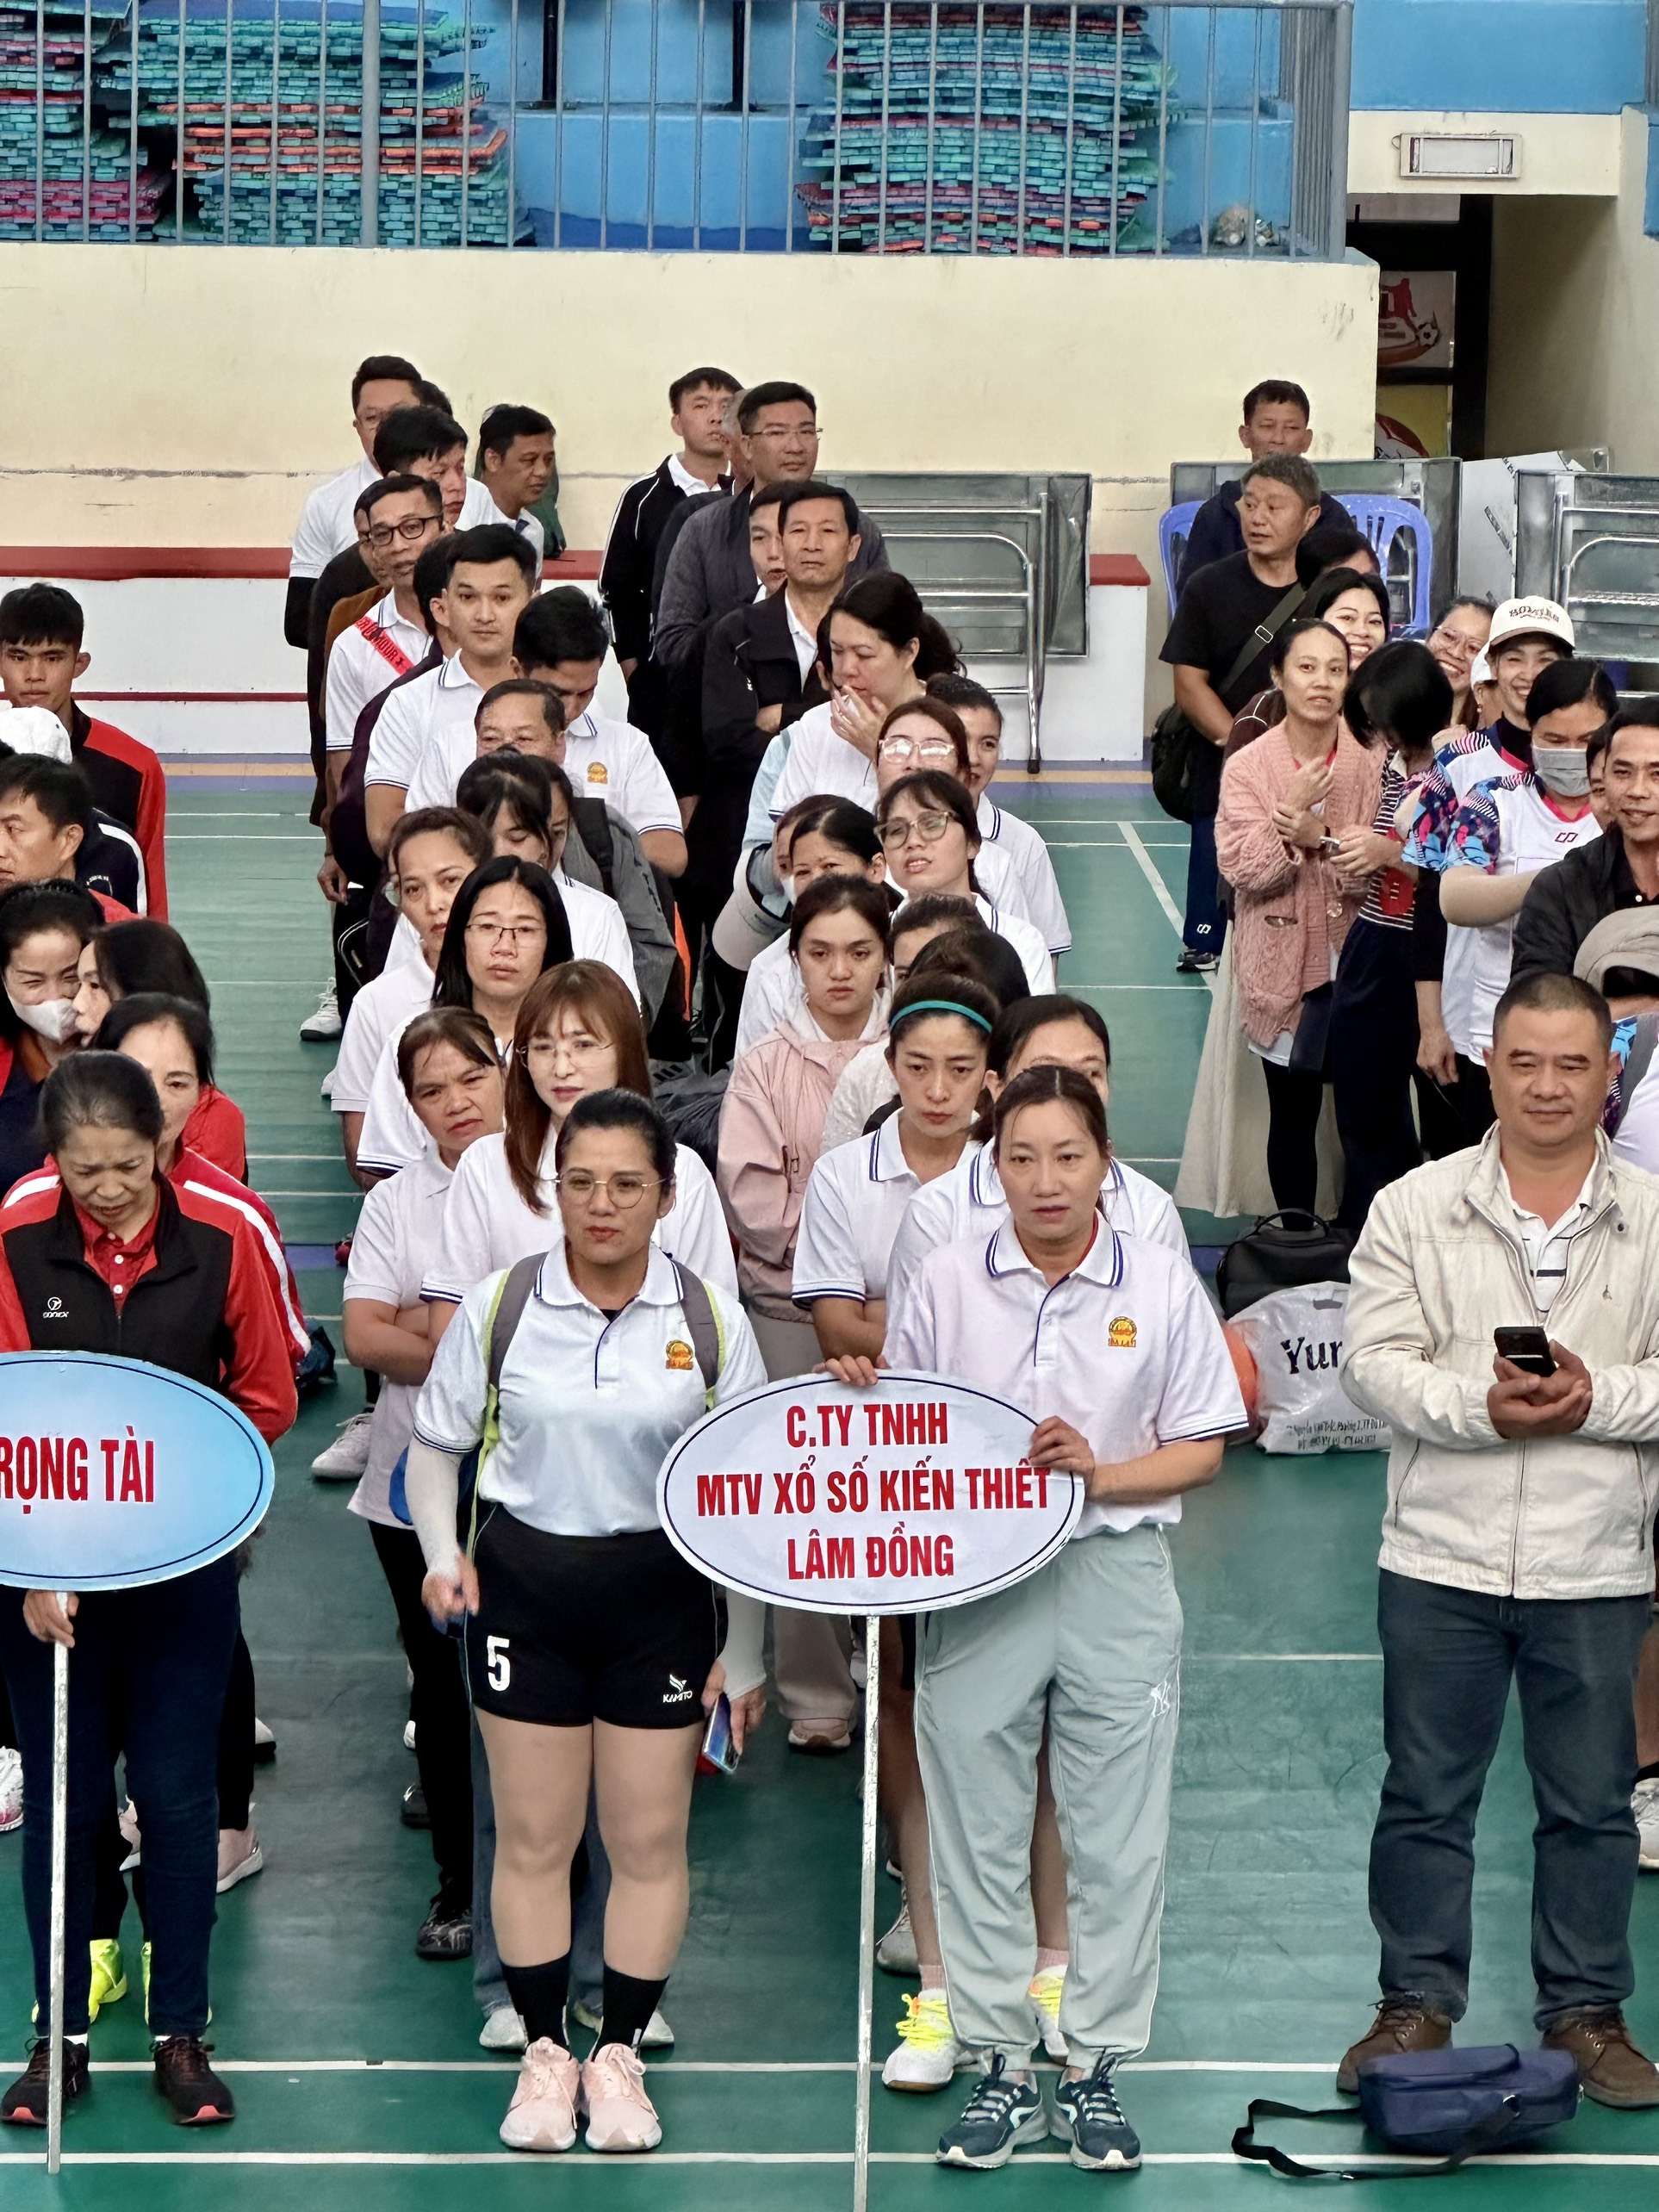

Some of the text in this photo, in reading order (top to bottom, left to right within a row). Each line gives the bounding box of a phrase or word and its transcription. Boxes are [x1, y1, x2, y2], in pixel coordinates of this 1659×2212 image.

[786, 1402, 948, 1448] C.TY TNHH
[100, 1426, 154, 1503] TÀI
[697, 1474, 762, 1517] MTV
[774, 1455, 816, 1514] XỔ
[827, 1456, 869, 1513] SỐ
[879, 1456, 954, 1512] KIẾN
[787, 1521, 954, 1580] LÂM ĐỒNG
[487, 1635, 511, 1692] 5
